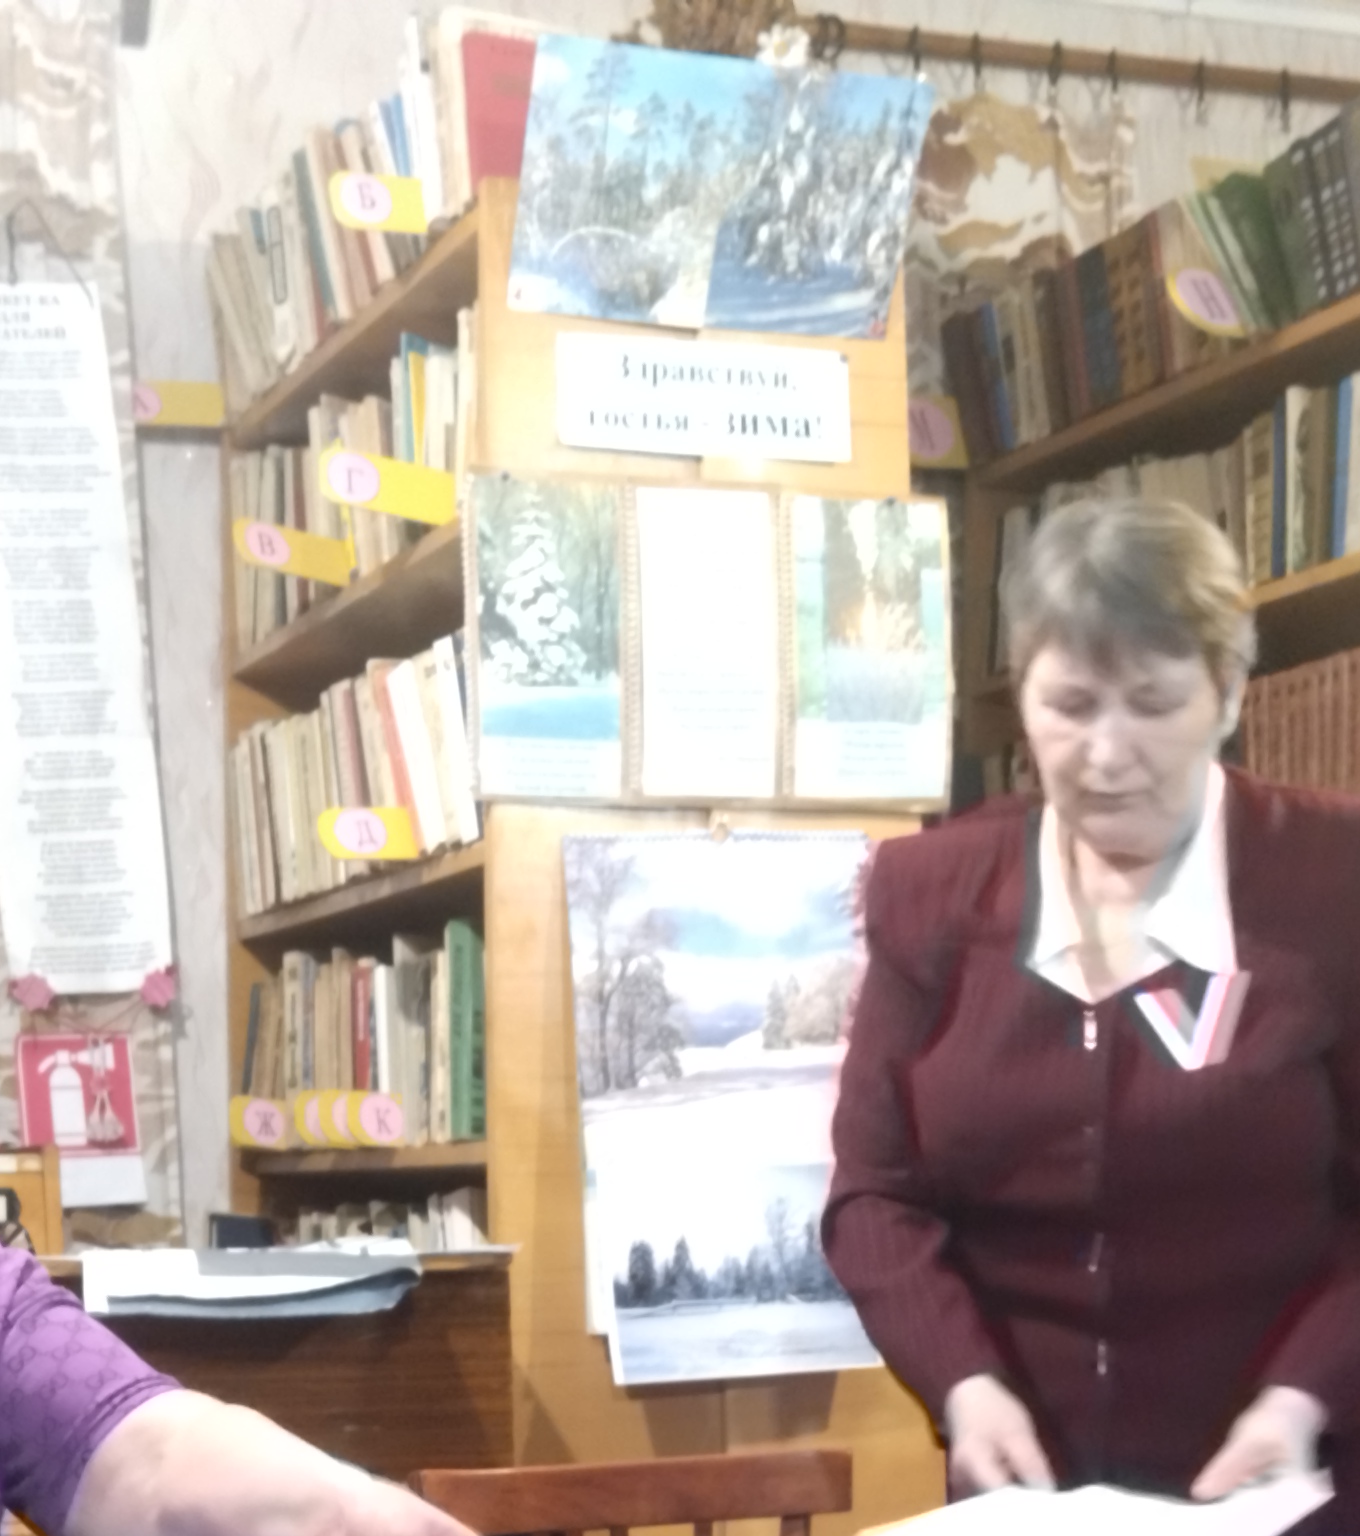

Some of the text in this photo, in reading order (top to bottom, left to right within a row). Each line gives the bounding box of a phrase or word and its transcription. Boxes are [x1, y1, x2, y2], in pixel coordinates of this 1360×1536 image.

[256, 531, 277, 556] В
[254, 1109, 278, 1137] Ж
[373, 1106, 393, 1136] К
